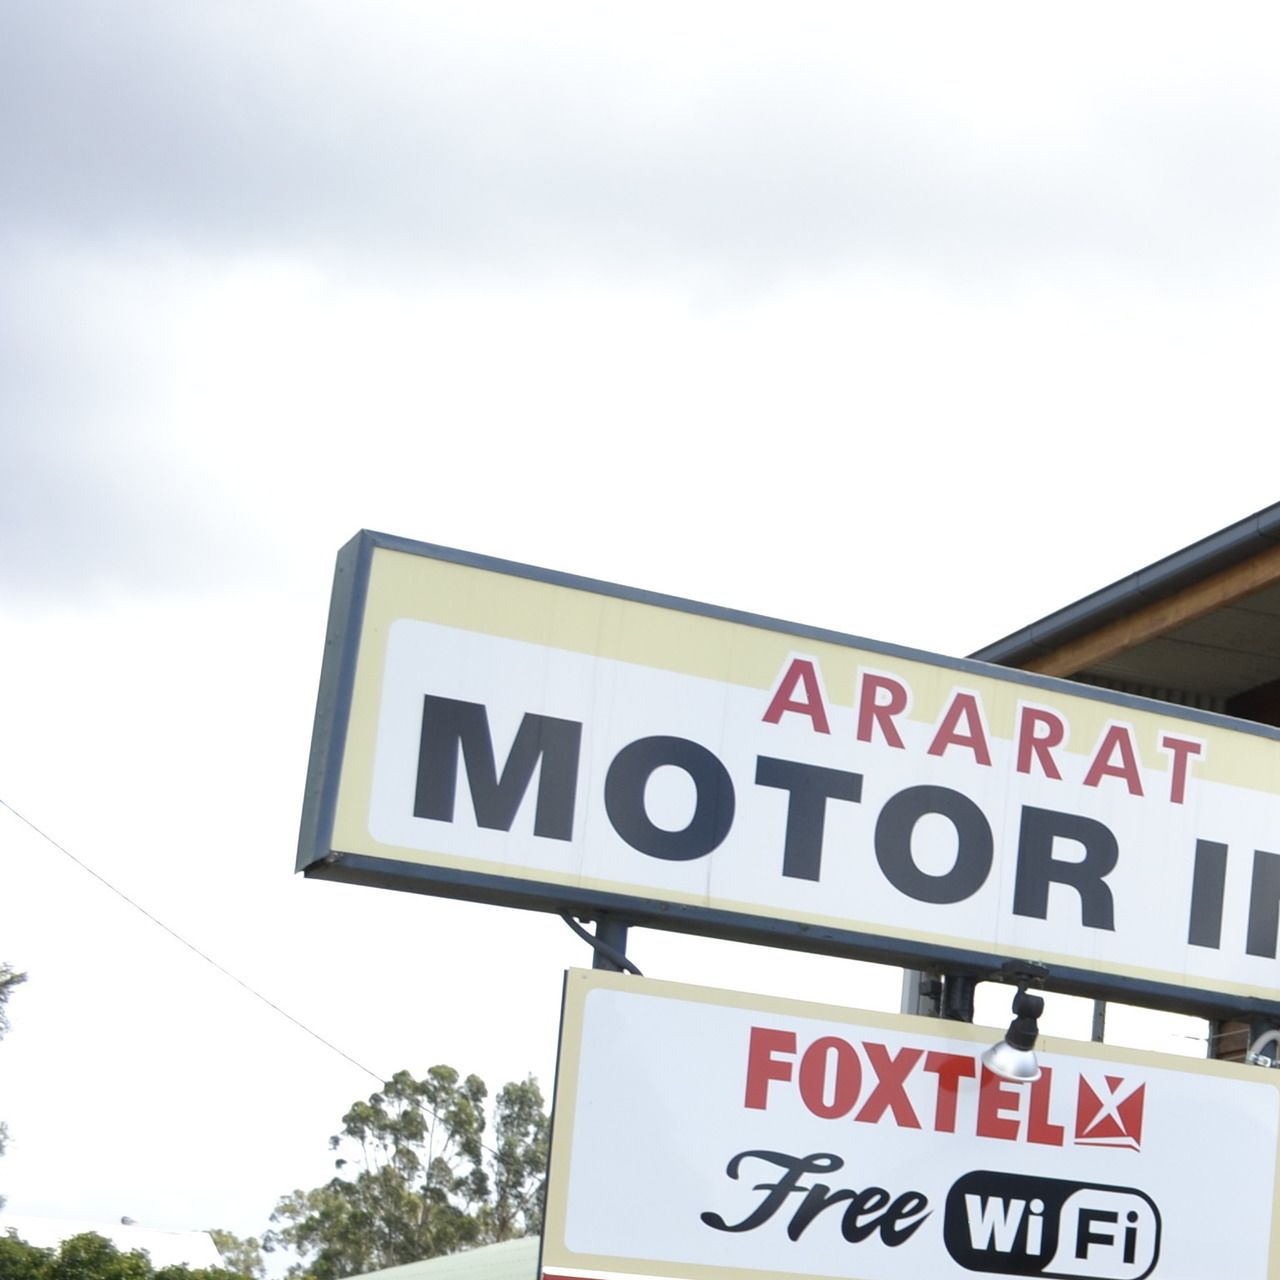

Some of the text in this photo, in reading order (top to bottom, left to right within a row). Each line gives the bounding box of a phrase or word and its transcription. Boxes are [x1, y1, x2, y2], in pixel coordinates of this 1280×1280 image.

[762, 657, 1202, 804] ARARAT
[413, 694, 1119, 932] MOTOR
[744, 1026, 1065, 1147] FOXTEL
[700, 1150, 932, 1248] Free
